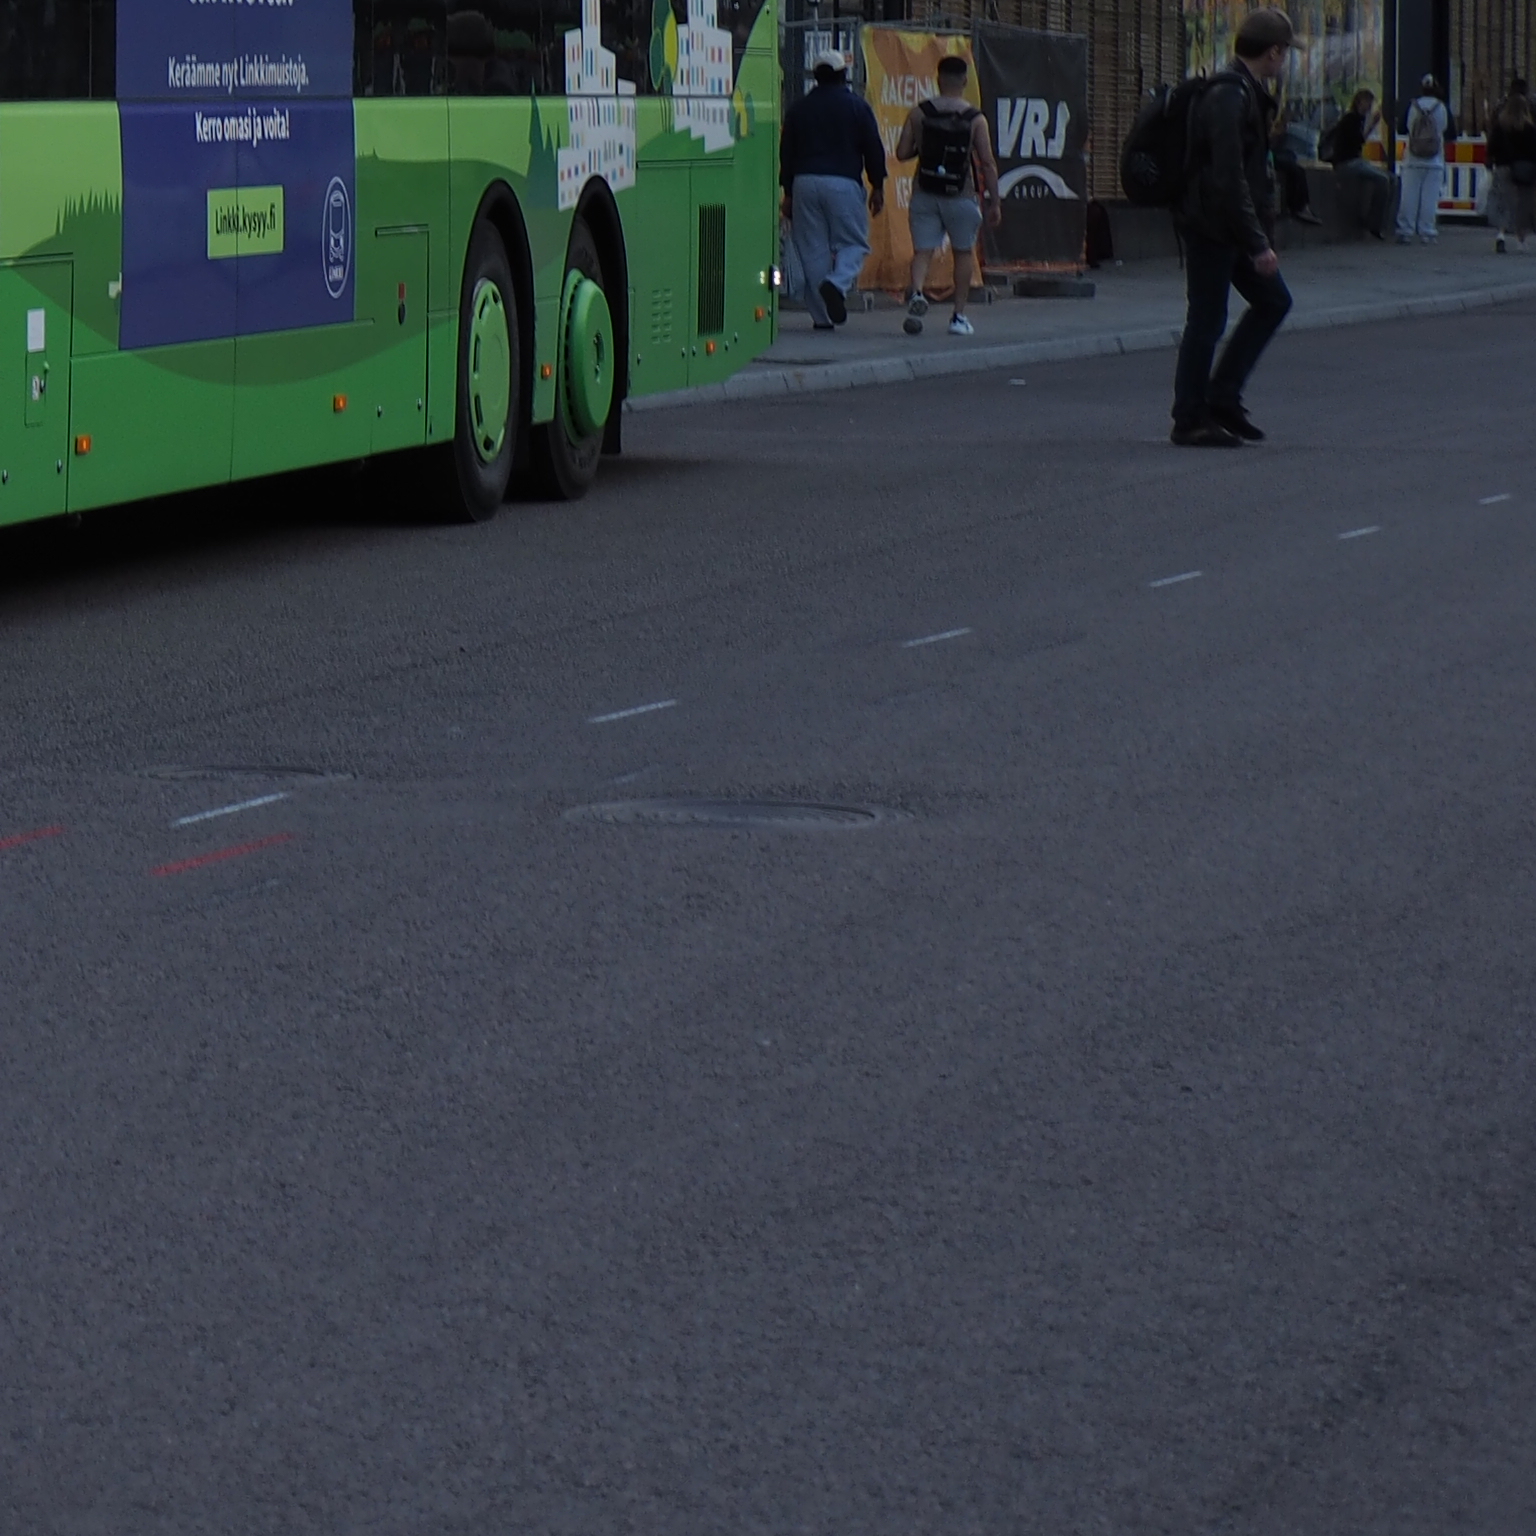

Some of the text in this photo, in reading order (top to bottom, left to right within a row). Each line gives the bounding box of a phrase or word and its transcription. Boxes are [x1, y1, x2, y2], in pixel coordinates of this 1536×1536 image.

[168, 53, 221, 88] Keräämme
[221, 57, 238, 95] nyt
[195, 106, 290, 149] Kerro omasi ja voita!
